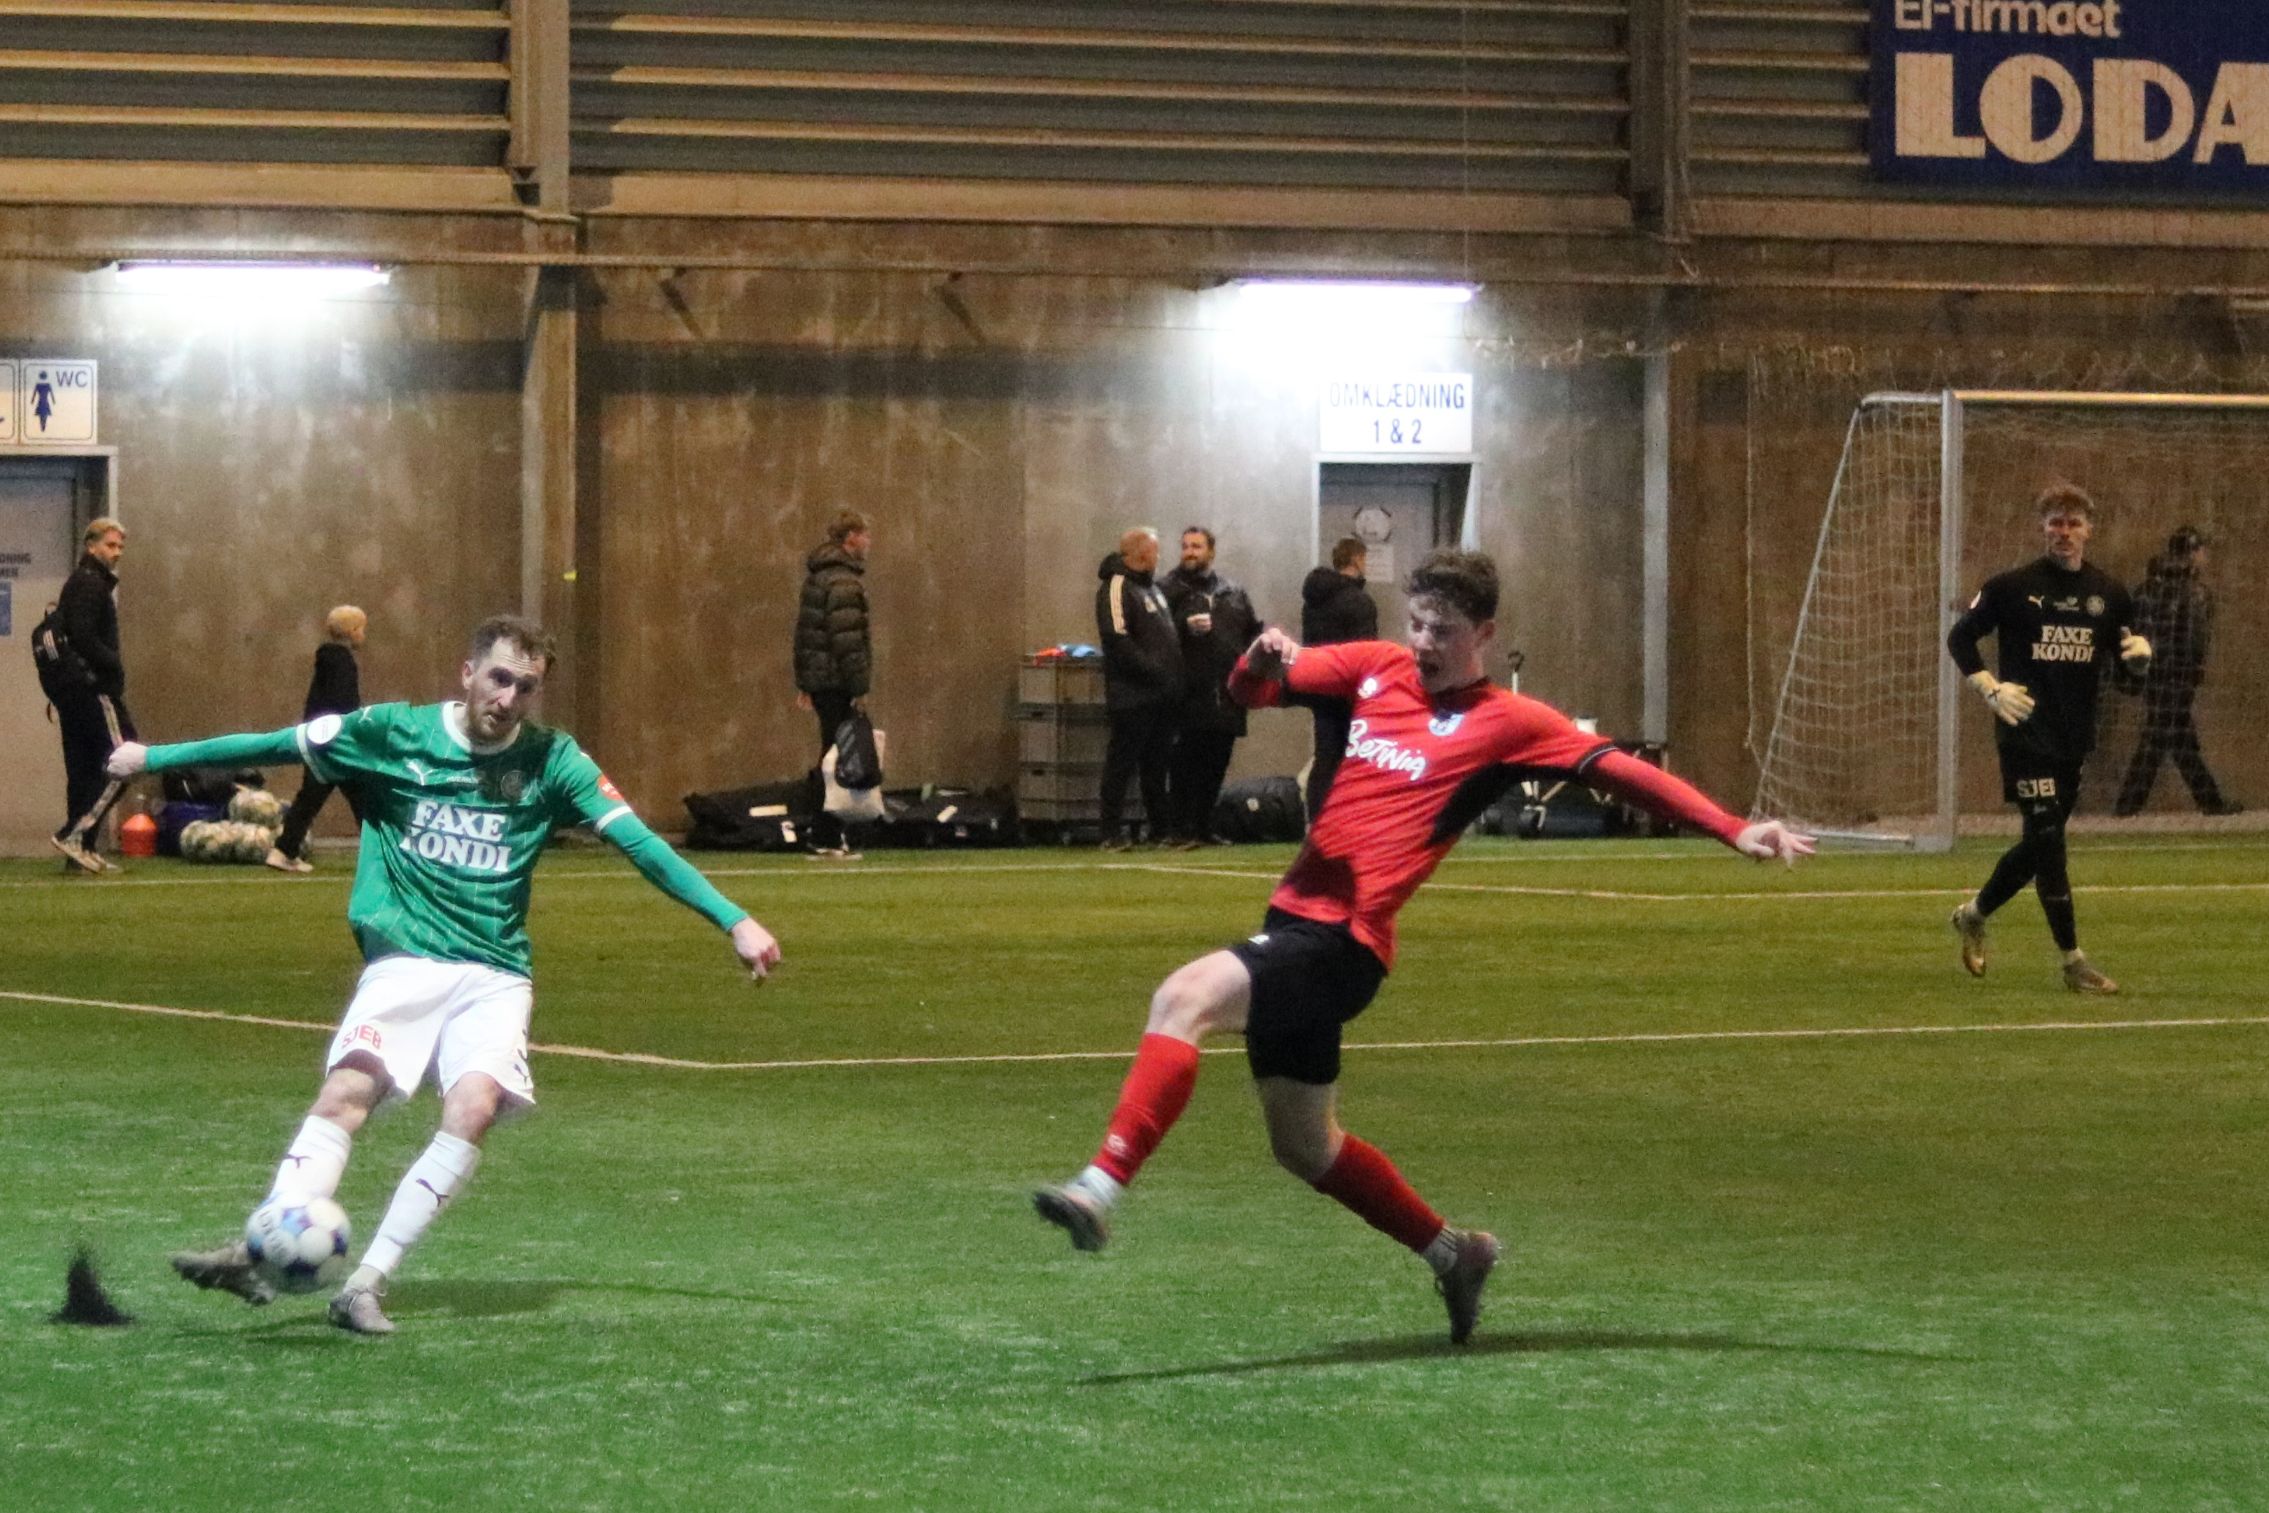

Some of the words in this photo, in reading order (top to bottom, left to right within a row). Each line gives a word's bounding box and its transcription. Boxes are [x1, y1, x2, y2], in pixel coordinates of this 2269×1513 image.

[56, 370, 88, 388] WC
[1330, 383, 1464, 409] OMKLÆDNING
[1374, 420, 1380, 444] 1
[1390, 418, 1403, 444] &
[1411, 419, 1422, 444] 2
[2041, 625, 2093, 645] FAXE
[2031, 643, 2096, 662] KONDI
[412, 800, 506, 842] FAXE
